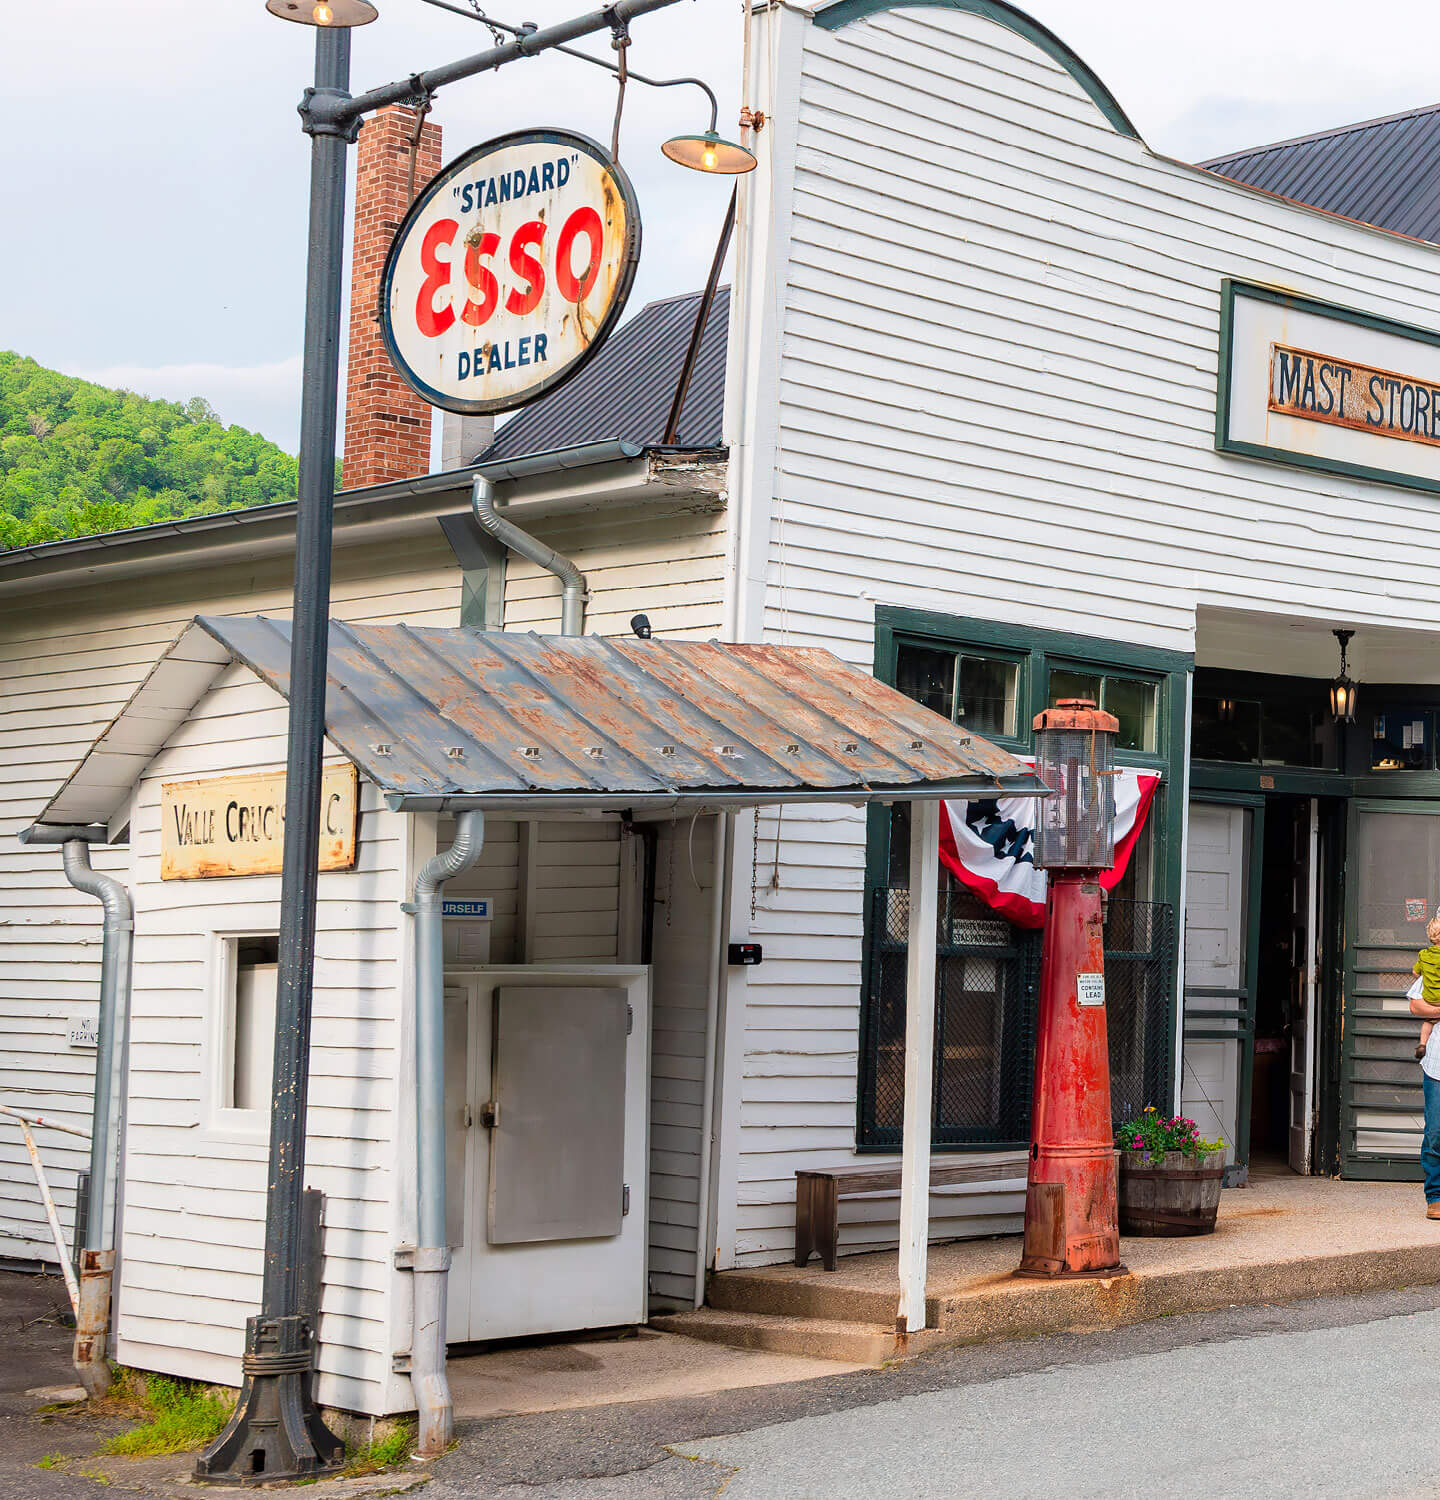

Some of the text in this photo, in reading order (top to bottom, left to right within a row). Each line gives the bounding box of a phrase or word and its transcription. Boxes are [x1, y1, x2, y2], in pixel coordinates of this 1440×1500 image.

[453, 154, 579, 214] "STANDARD"
[415, 206, 604, 338] ESSO
[457, 332, 549, 381] DEALER
[1278, 352, 1352, 418] MAST
[1085, 991, 1102, 999] LEAD
